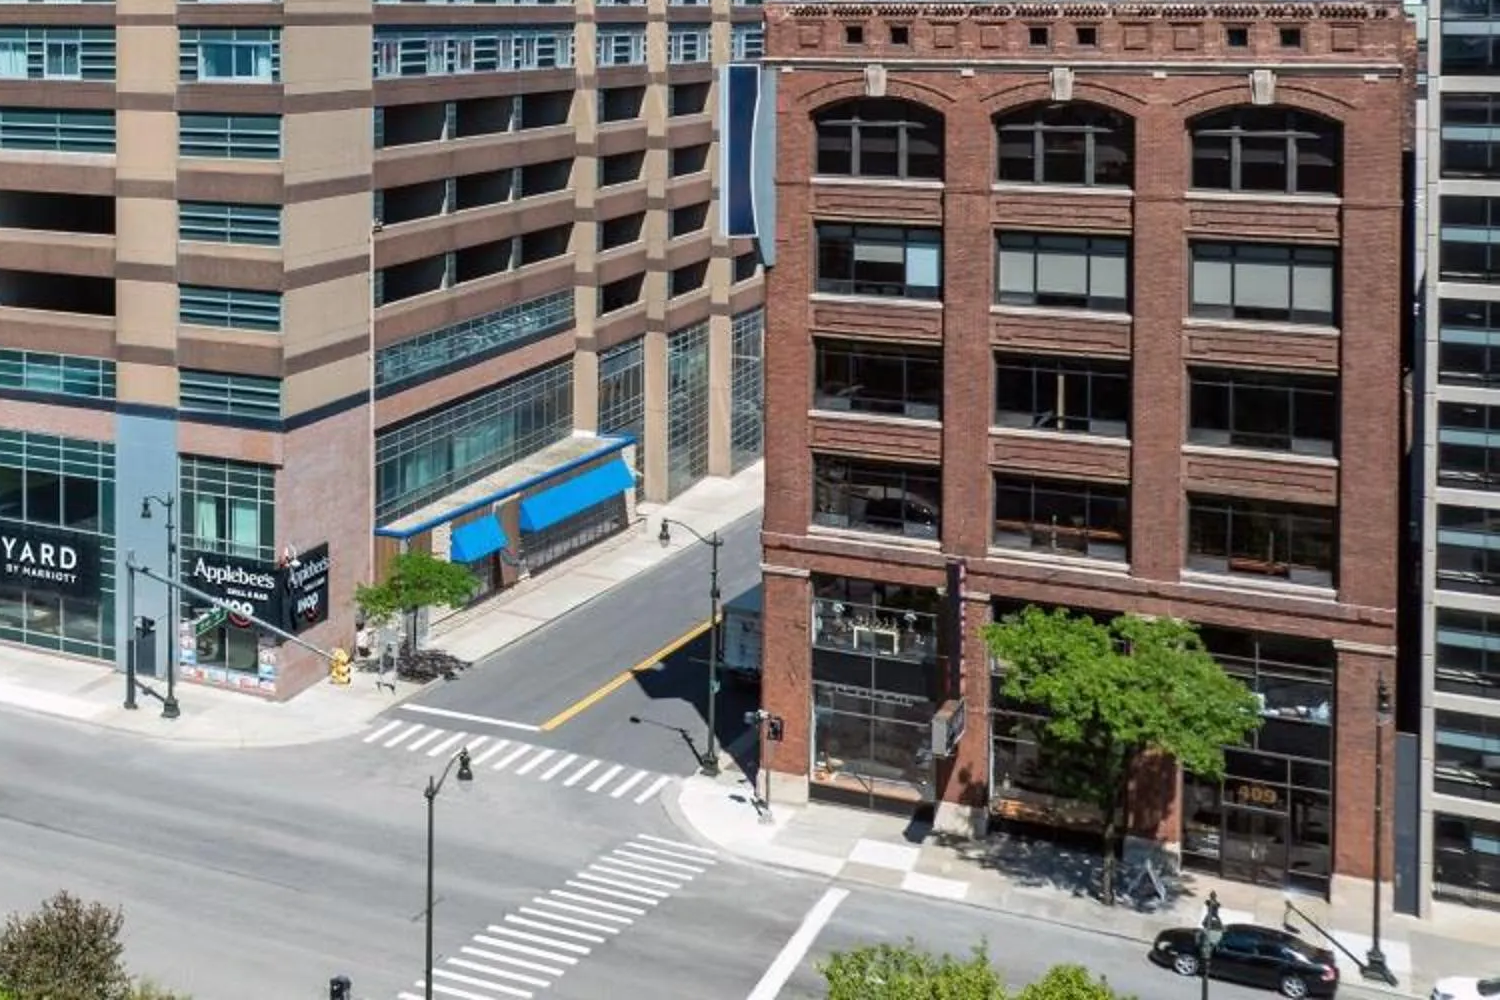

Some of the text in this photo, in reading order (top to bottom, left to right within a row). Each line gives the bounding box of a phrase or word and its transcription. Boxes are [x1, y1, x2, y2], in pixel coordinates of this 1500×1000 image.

[6, 564, 77, 584] BY MARRIOTT
[194, 557, 275, 589] Applebee's
